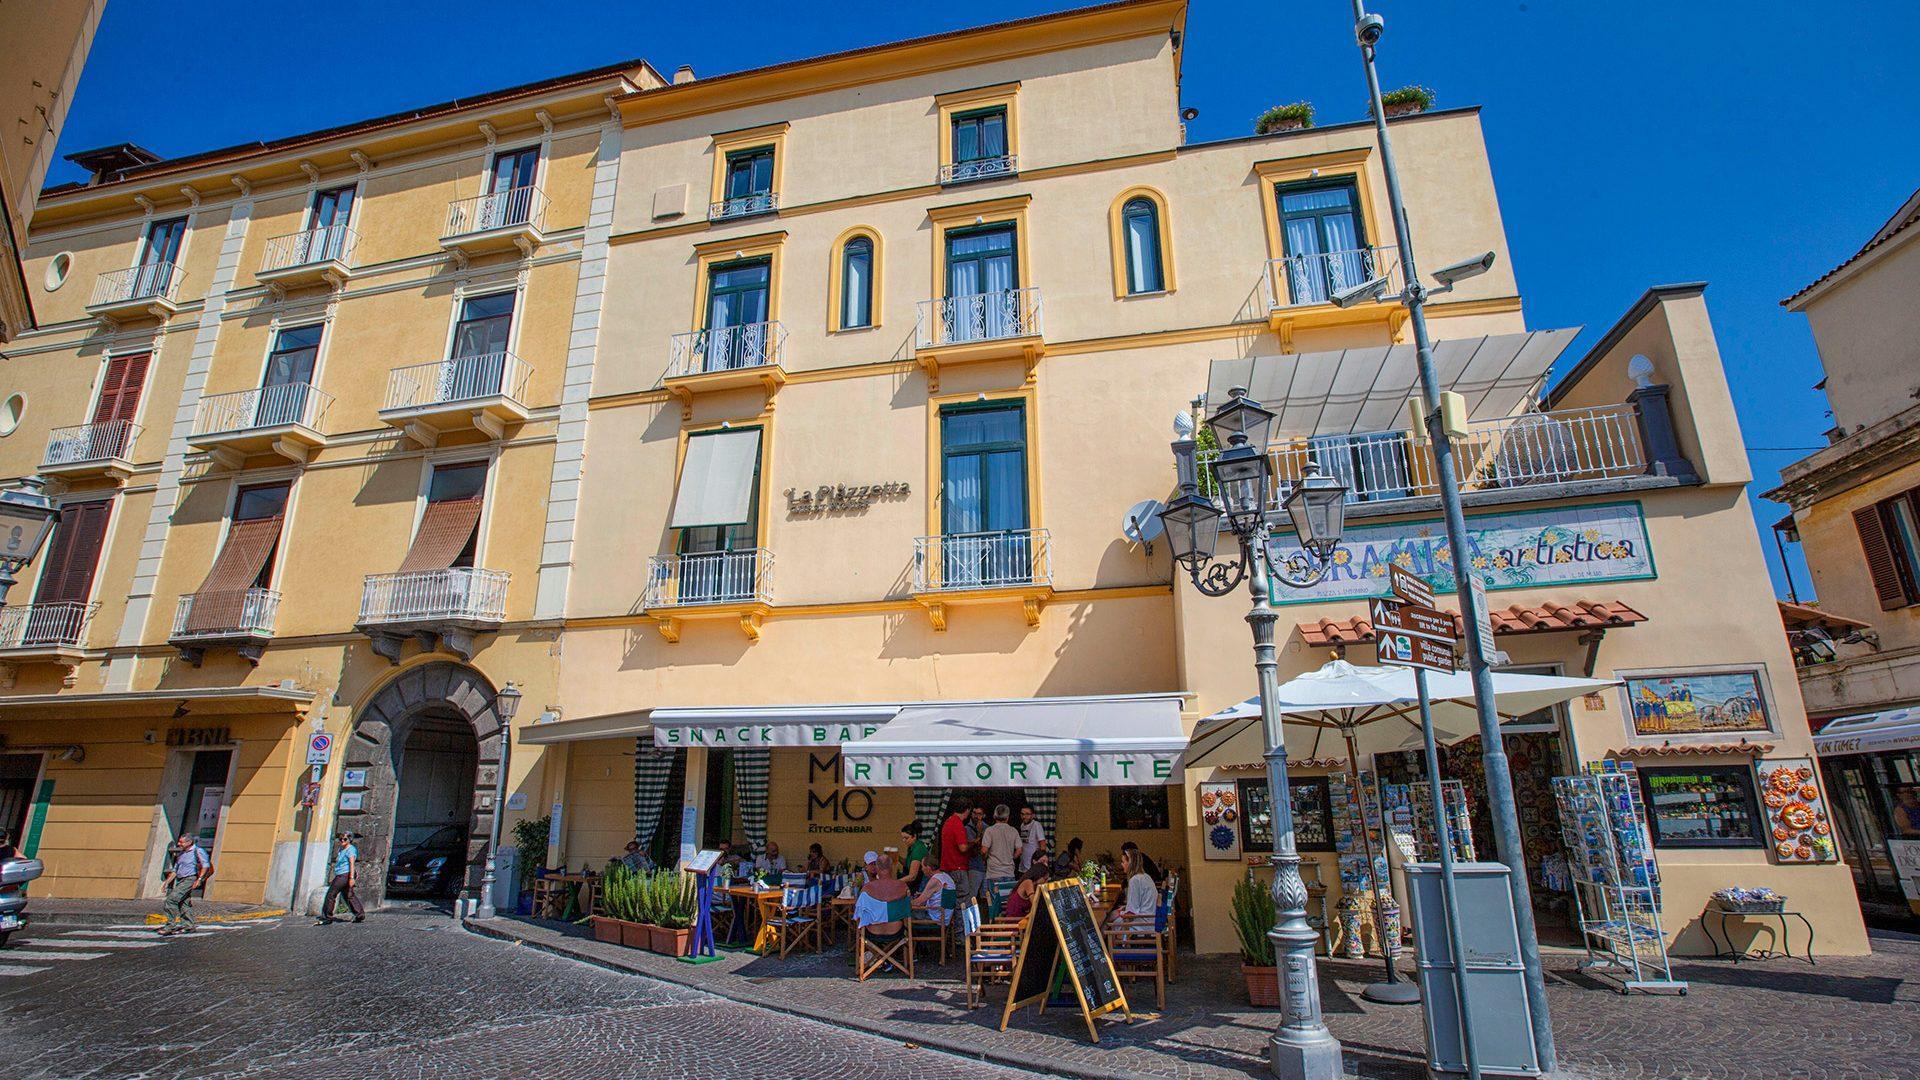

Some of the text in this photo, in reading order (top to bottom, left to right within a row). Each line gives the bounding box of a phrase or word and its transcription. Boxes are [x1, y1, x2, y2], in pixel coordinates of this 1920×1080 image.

[668, 728, 773, 743] SNACK
[1821, 741, 1831, 753] IN
[854, 759, 1171, 781] RISTORANTE
